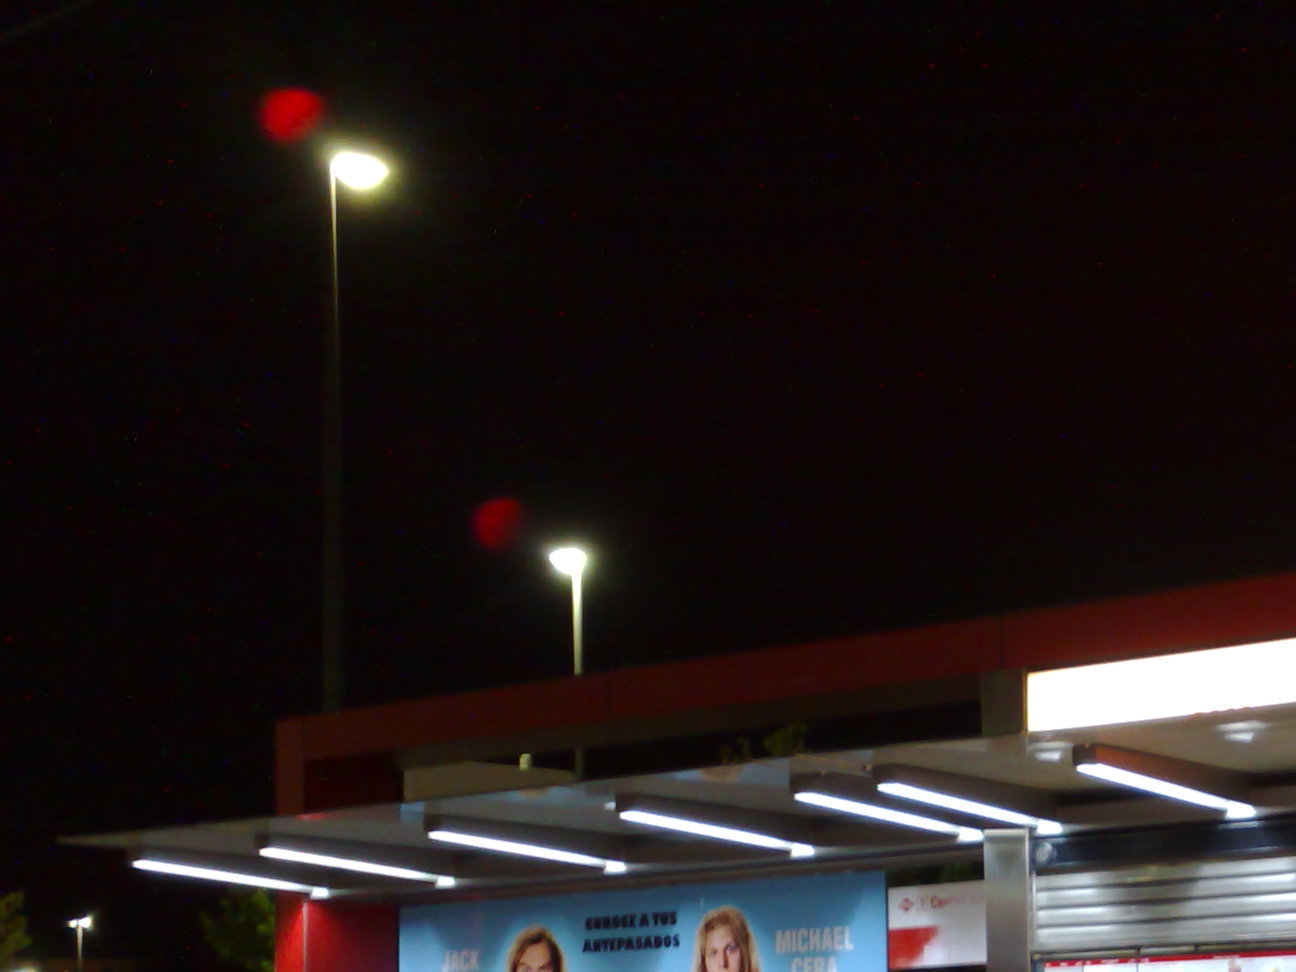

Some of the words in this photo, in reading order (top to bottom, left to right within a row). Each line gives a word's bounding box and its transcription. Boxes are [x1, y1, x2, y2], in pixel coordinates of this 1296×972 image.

[639, 913, 649, 927] A
[652, 911, 677, 926] TUS
[583, 935, 680, 953] ANTEPASADOS
[775, 926, 854, 954] MICHAEL
[442, 949, 480, 972] JACK
